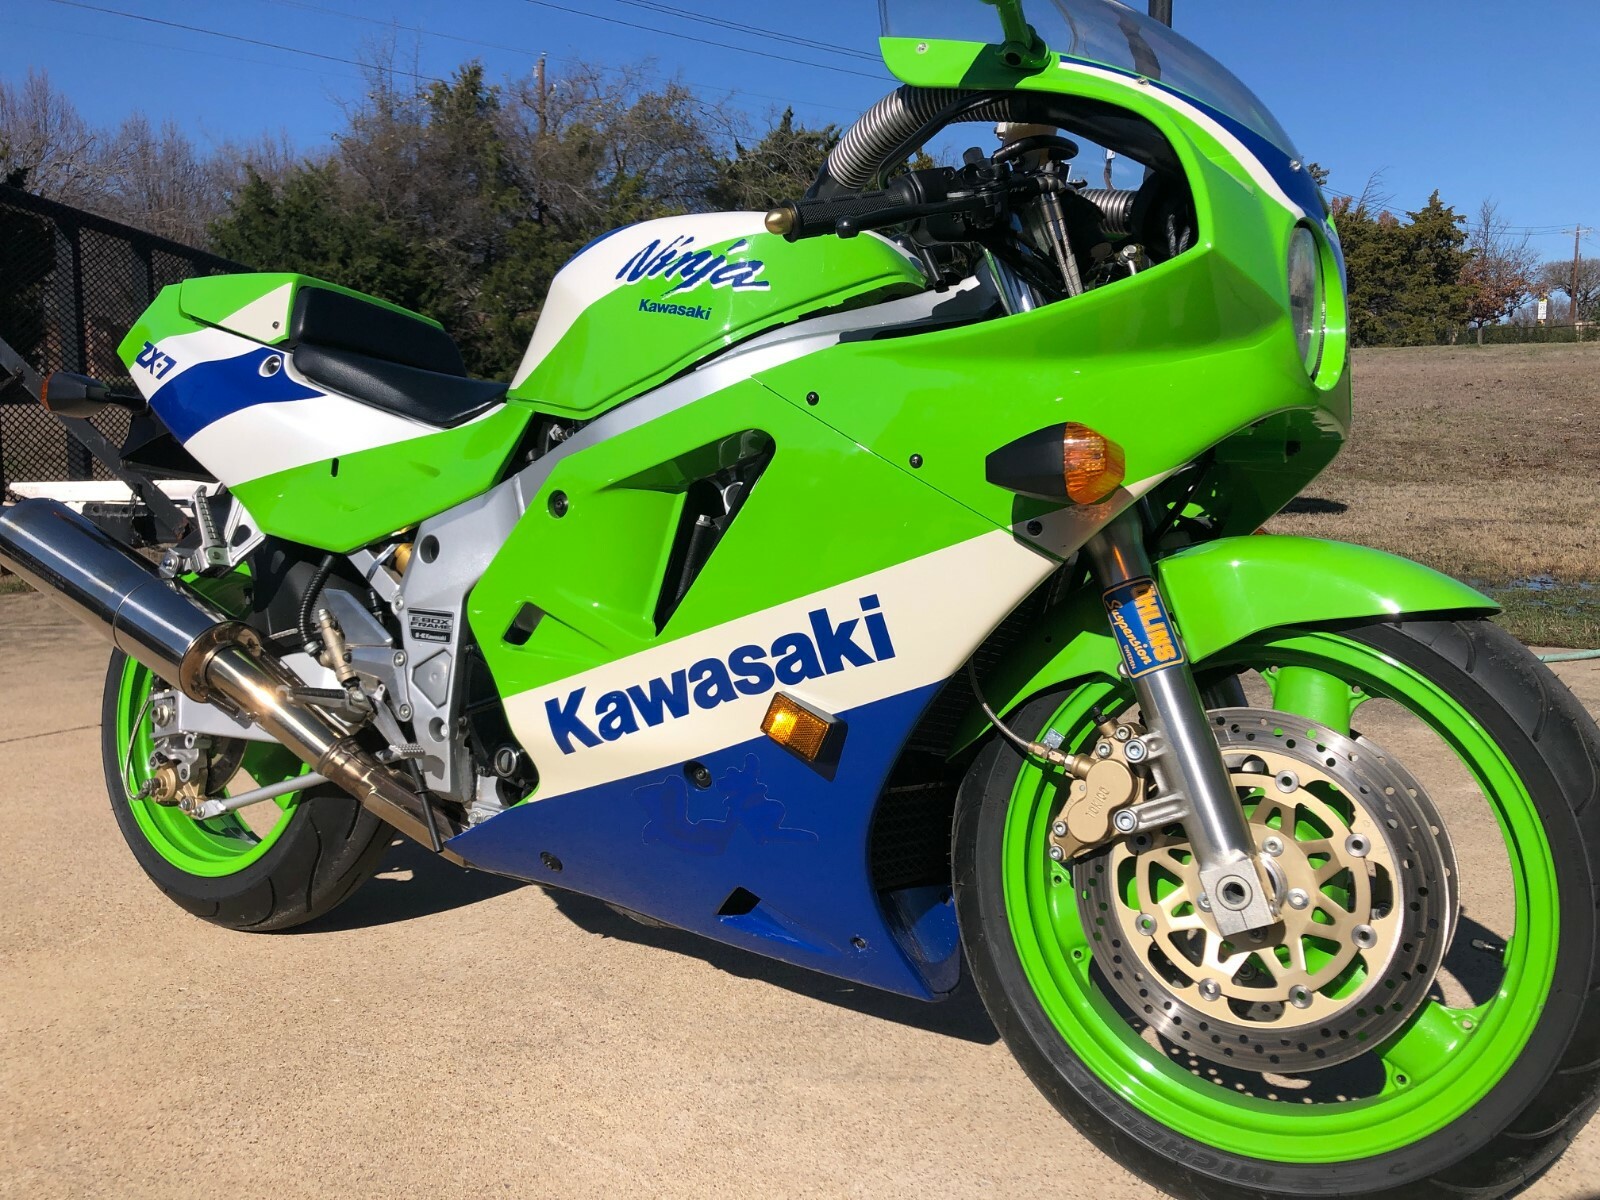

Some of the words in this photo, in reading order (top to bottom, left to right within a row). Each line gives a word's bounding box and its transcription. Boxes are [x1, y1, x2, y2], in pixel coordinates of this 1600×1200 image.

[615, 235, 771, 298] Ninja
[638, 298, 713, 320] Kawasaki
[135, 340, 178, 380] ZX-7
[410, 621, 453, 630] FRAME
[1105, 599, 1153, 665] Suspension
[544, 593, 896, 755] Kawasaki
[1123, 644, 1137, 670] SWEDEN
